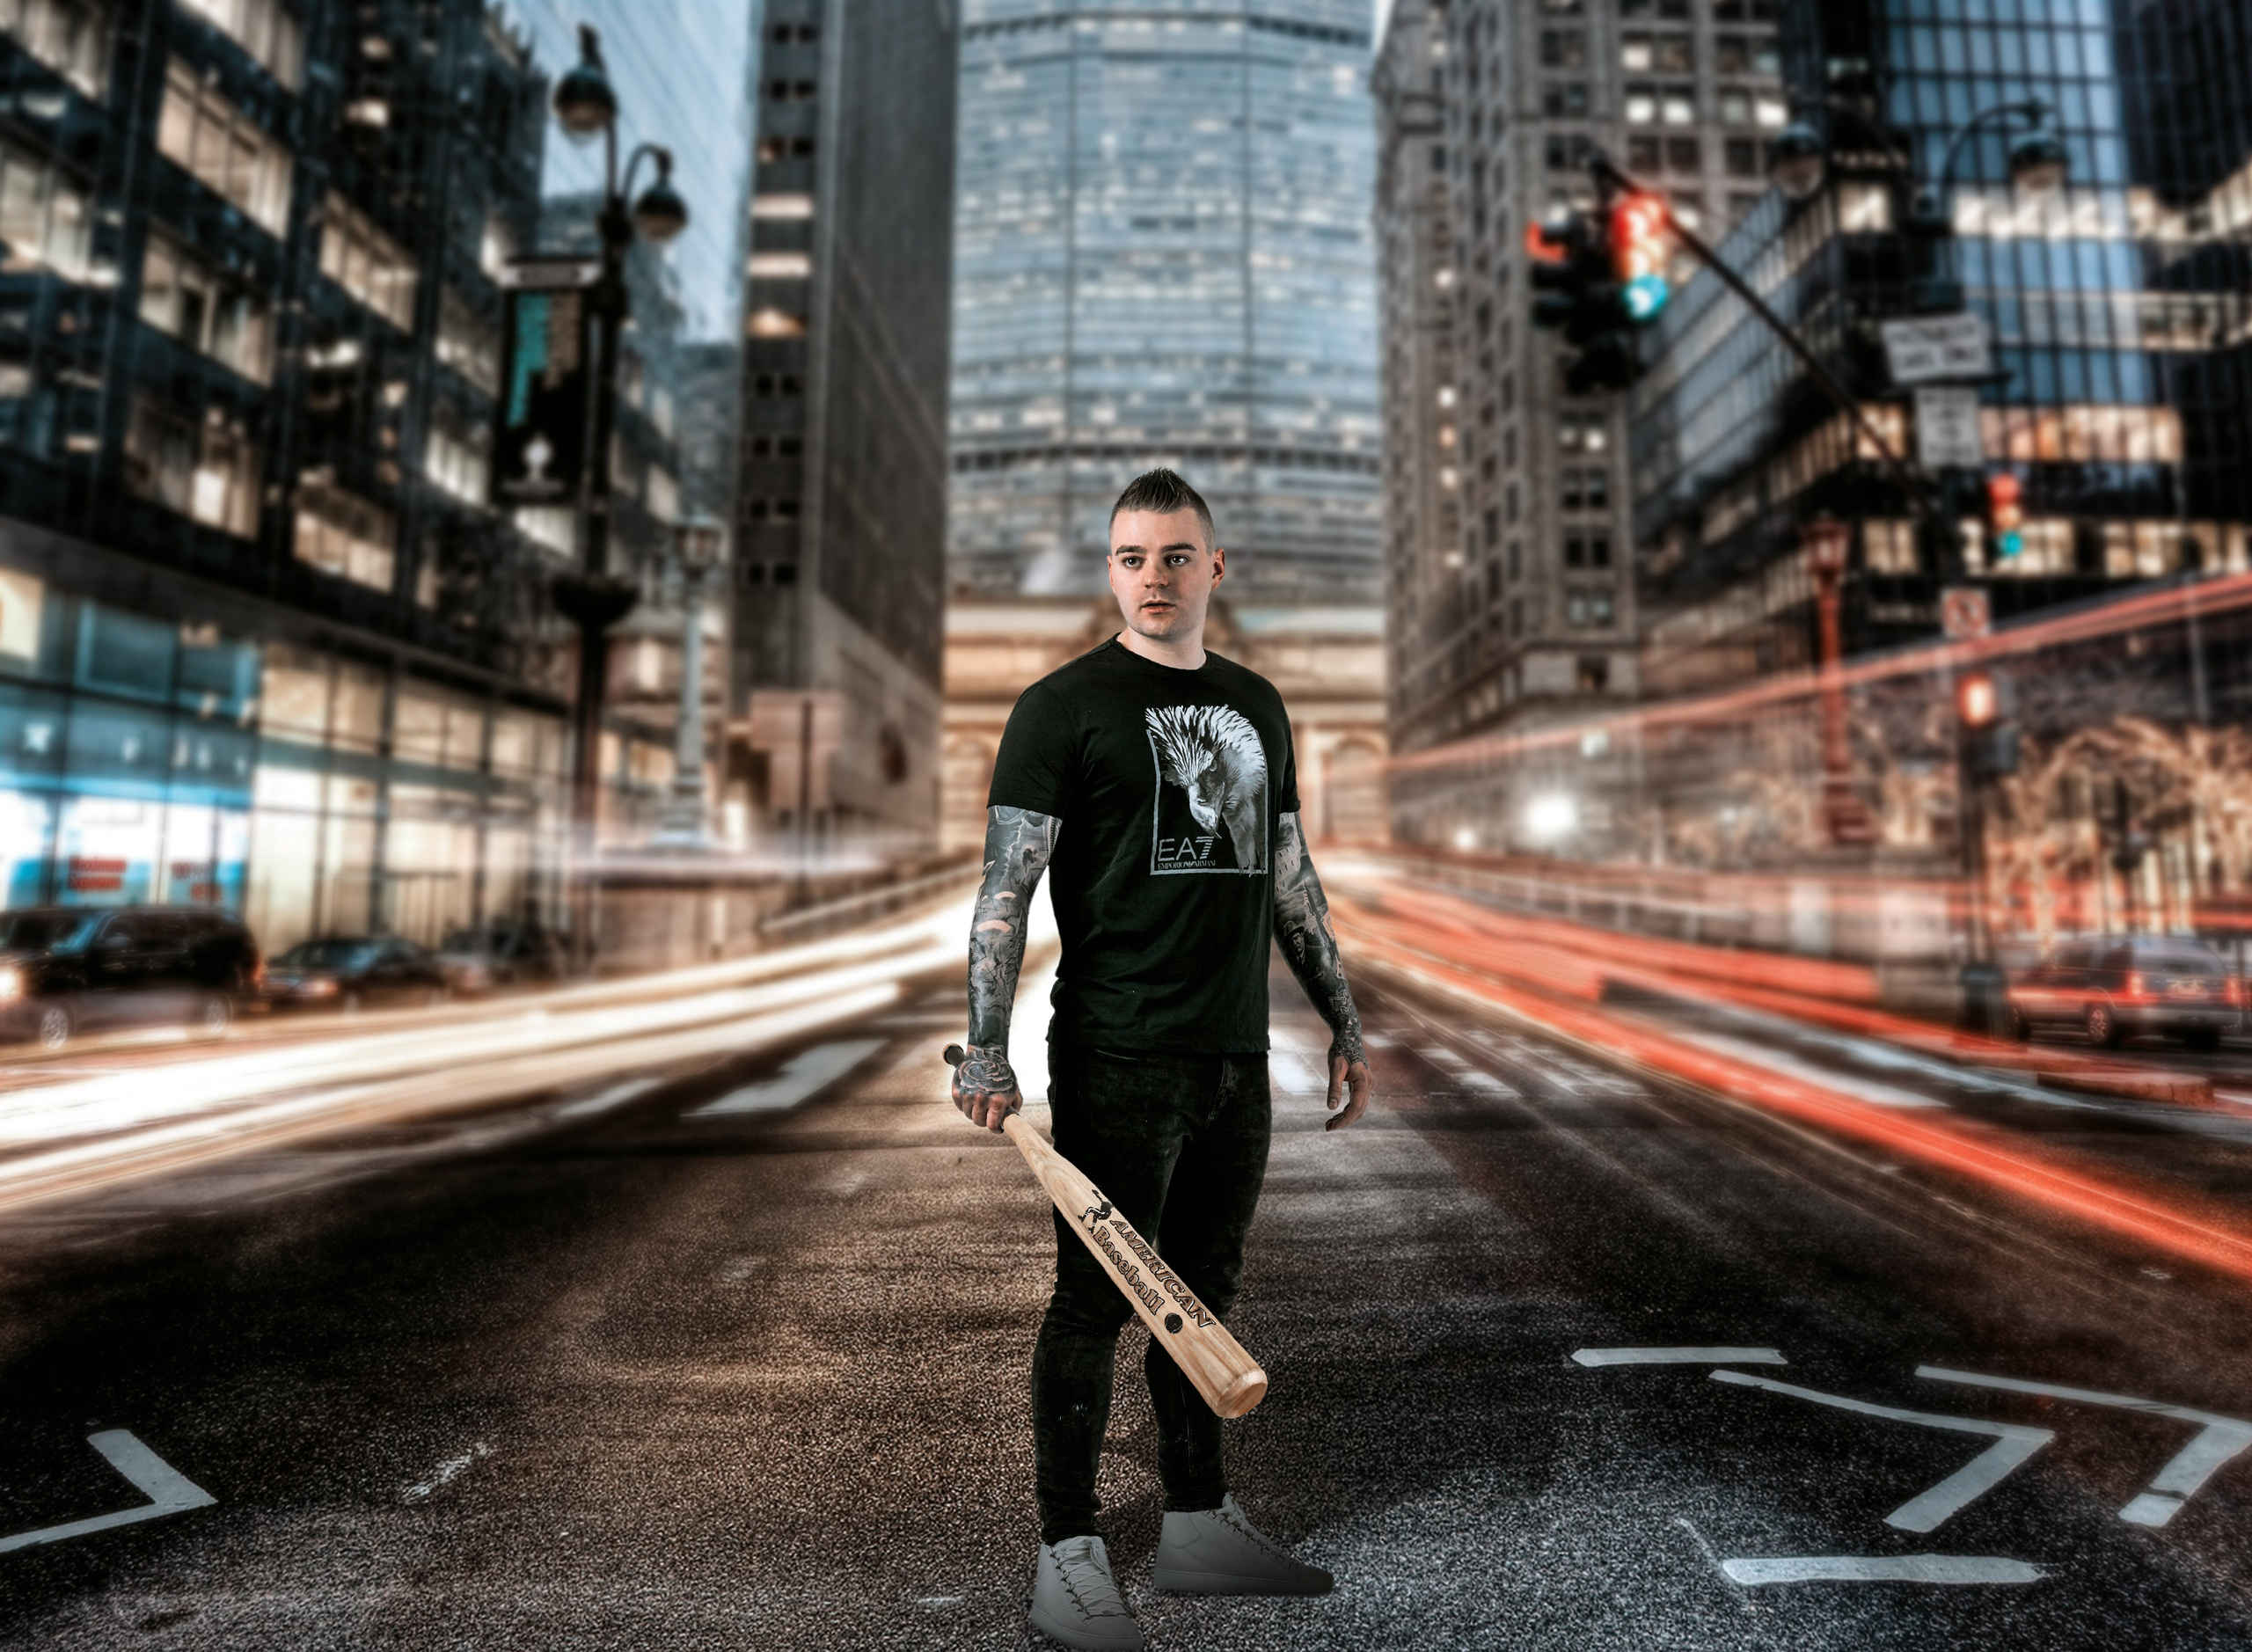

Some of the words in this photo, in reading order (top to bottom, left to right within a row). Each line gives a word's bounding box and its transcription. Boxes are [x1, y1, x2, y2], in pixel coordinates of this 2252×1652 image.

[1158, 836, 1214, 861] EA7
[1093, 1226, 1165, 1315] Baseball
[1109, 1219, 1216, 1327] AMERICAN
